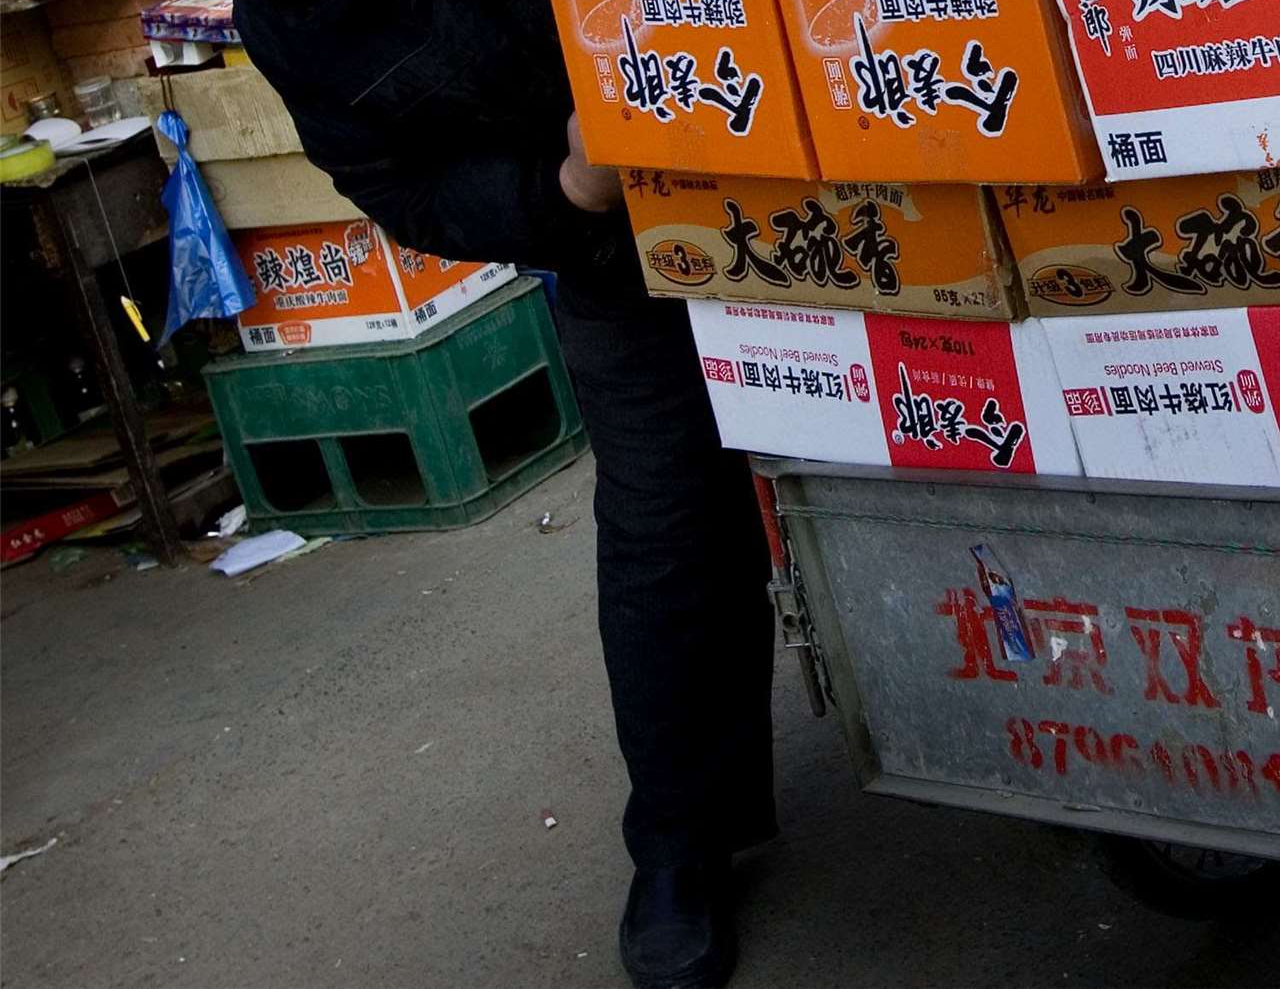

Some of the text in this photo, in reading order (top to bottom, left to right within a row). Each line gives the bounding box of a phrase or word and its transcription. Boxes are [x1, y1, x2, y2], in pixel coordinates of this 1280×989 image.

[618, 13, 765, 137] 今麦郎
[852, 12, 1020, 139] 今麦郎
[1107, 129, 1164, 168] 桶面
[255, 242, 351, 293] 辣煌尚
[721, 196, 902, 295] 大碗香
[742, 360, 845, 400] 红烧牛肉面
[1104, 359, 1224, 379] Stewed Beef Noodles
[892, 363, 1027, 468] 今麦郎
[1063, 387, 1102, 417] 珍品
[1112, 382, 1234, 416] 红烧牛肉面
